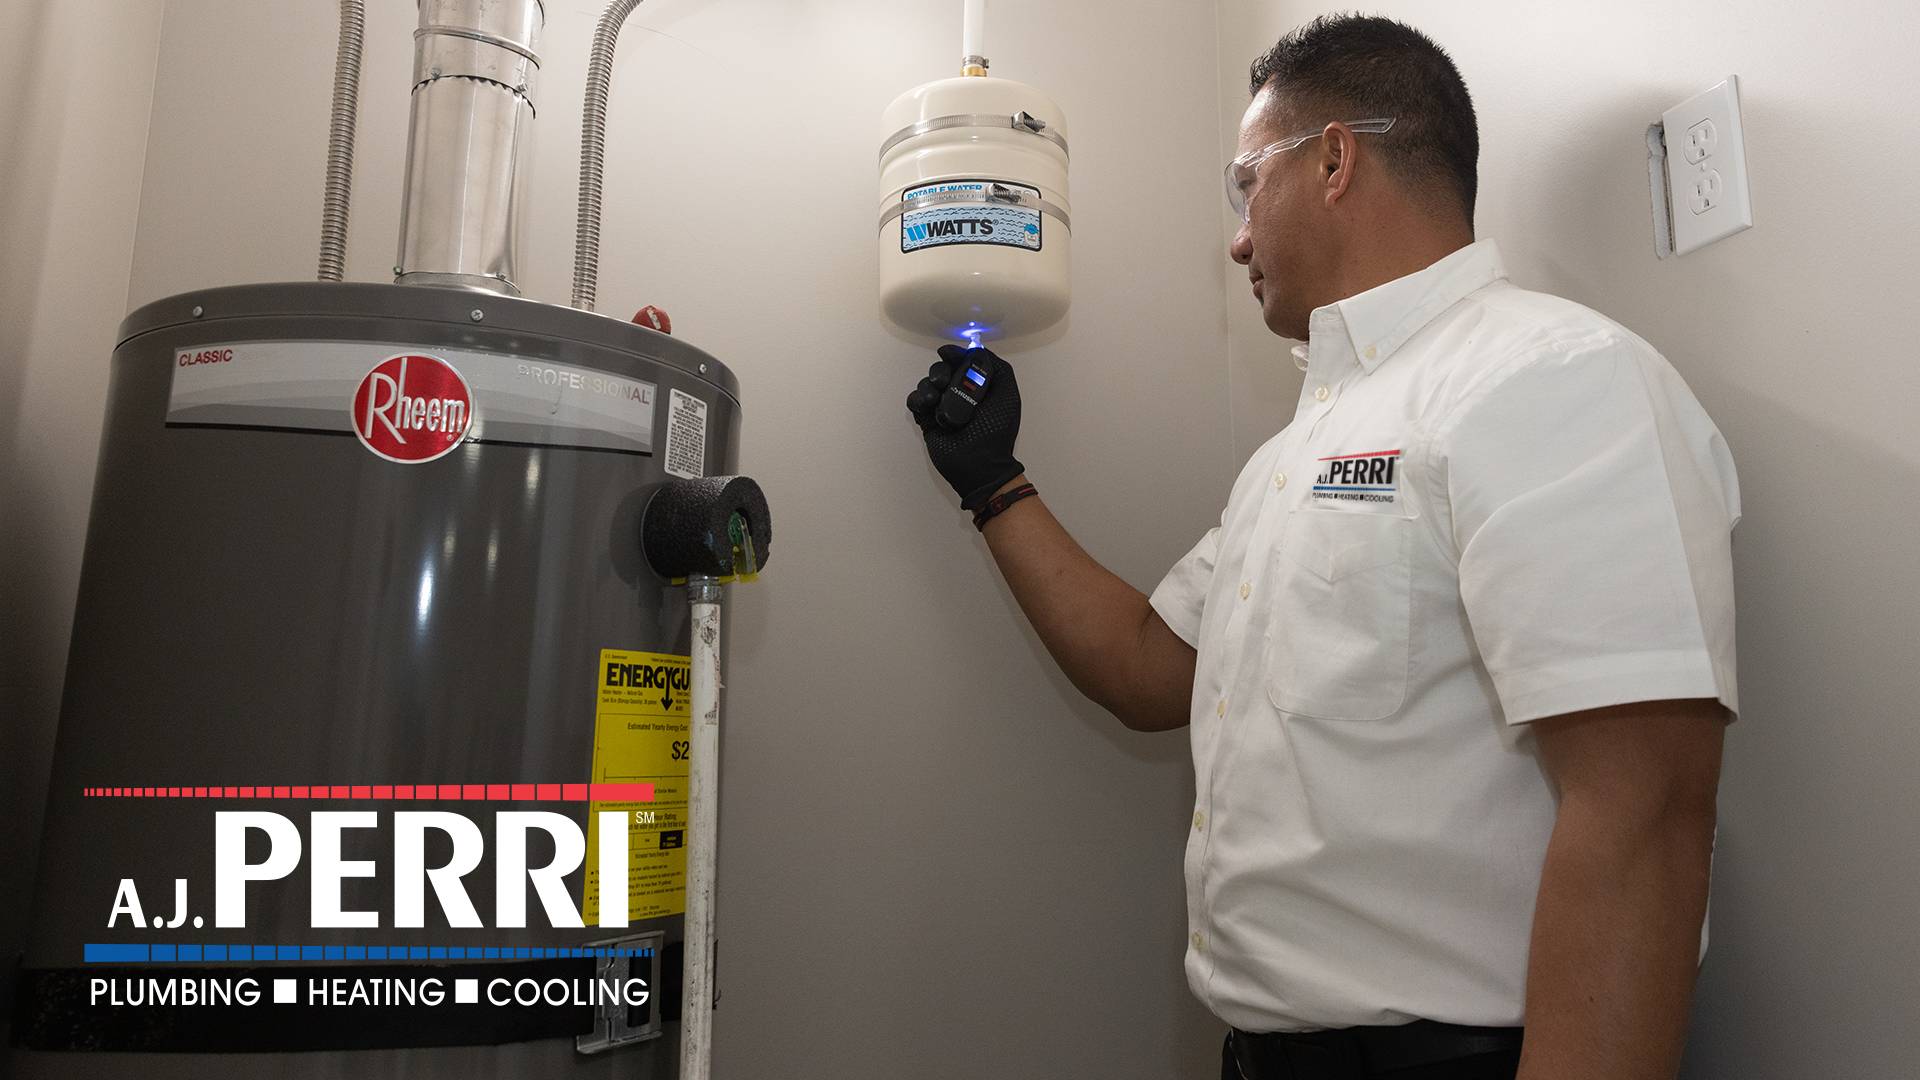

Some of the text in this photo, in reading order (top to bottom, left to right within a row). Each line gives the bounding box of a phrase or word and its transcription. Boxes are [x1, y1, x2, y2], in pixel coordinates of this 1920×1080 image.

[179, 349, 233, 367] CLASSIC
[364, 357, 465, 444] Rheem
[1329, 456, 1394, 485] PERRI
[1363, 495, 1394, 503] COOLING
